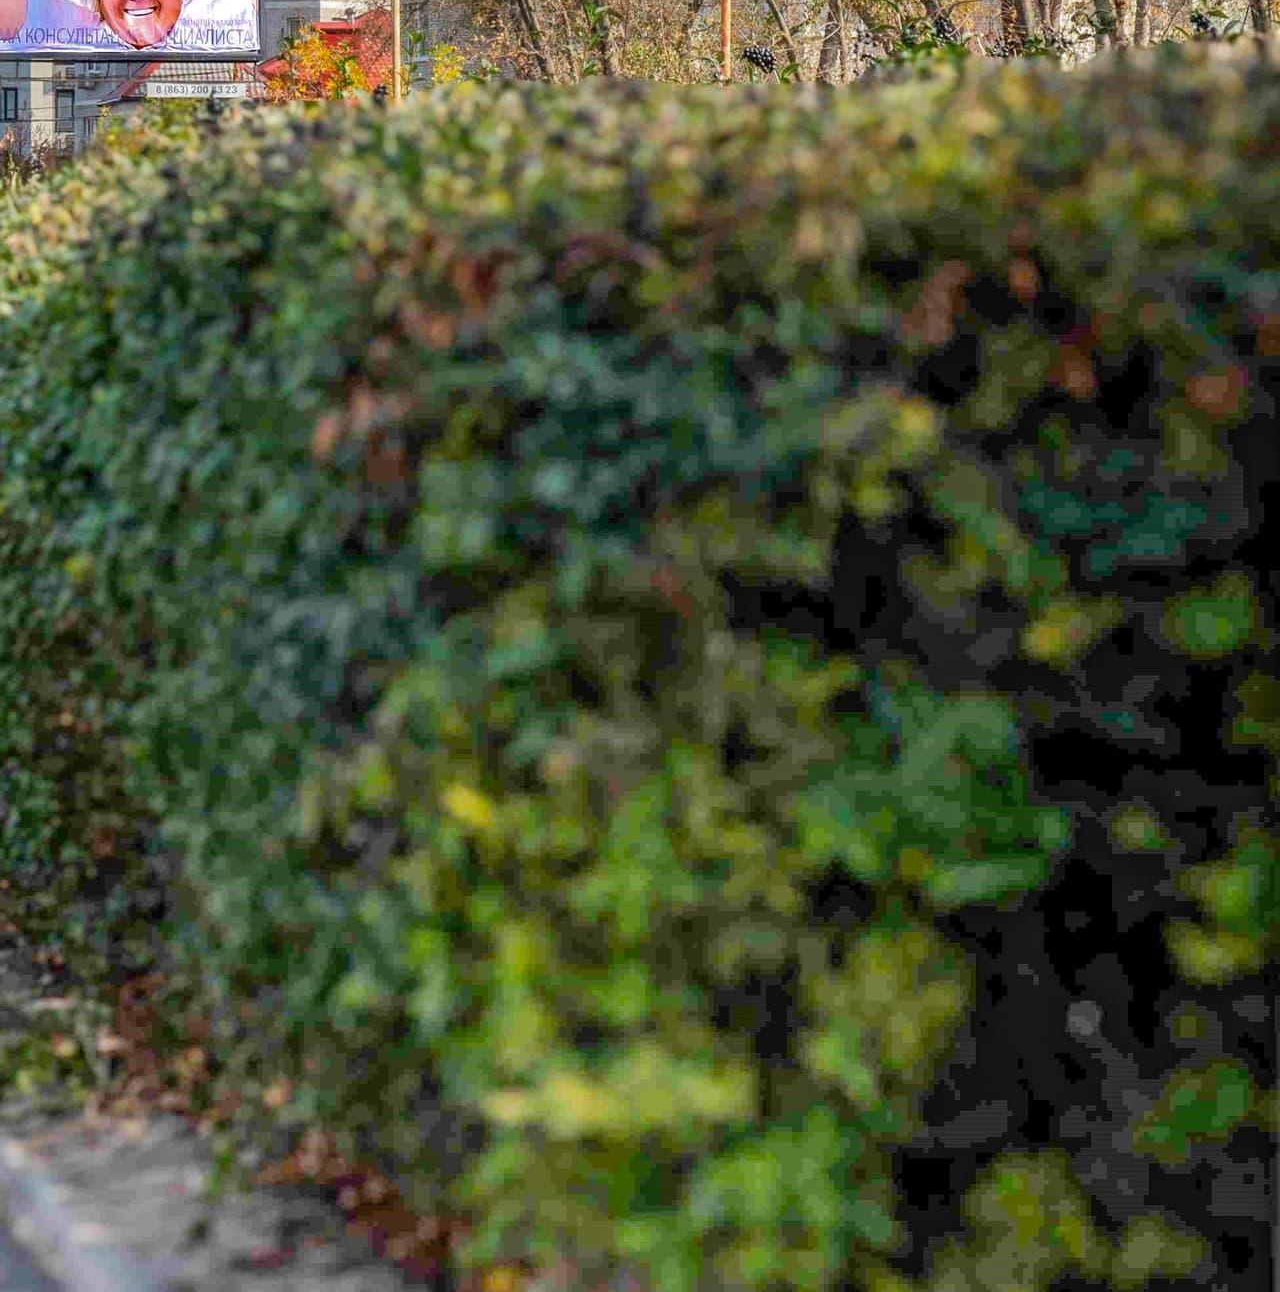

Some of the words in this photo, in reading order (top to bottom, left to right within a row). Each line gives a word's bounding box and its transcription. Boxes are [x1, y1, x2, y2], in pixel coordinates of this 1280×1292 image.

[155, 85, 162, 94] 8
[164, 85, 189, 95] (863)
[191, 85, 209, 94] 200
[225, 85, 238, 94] 23
